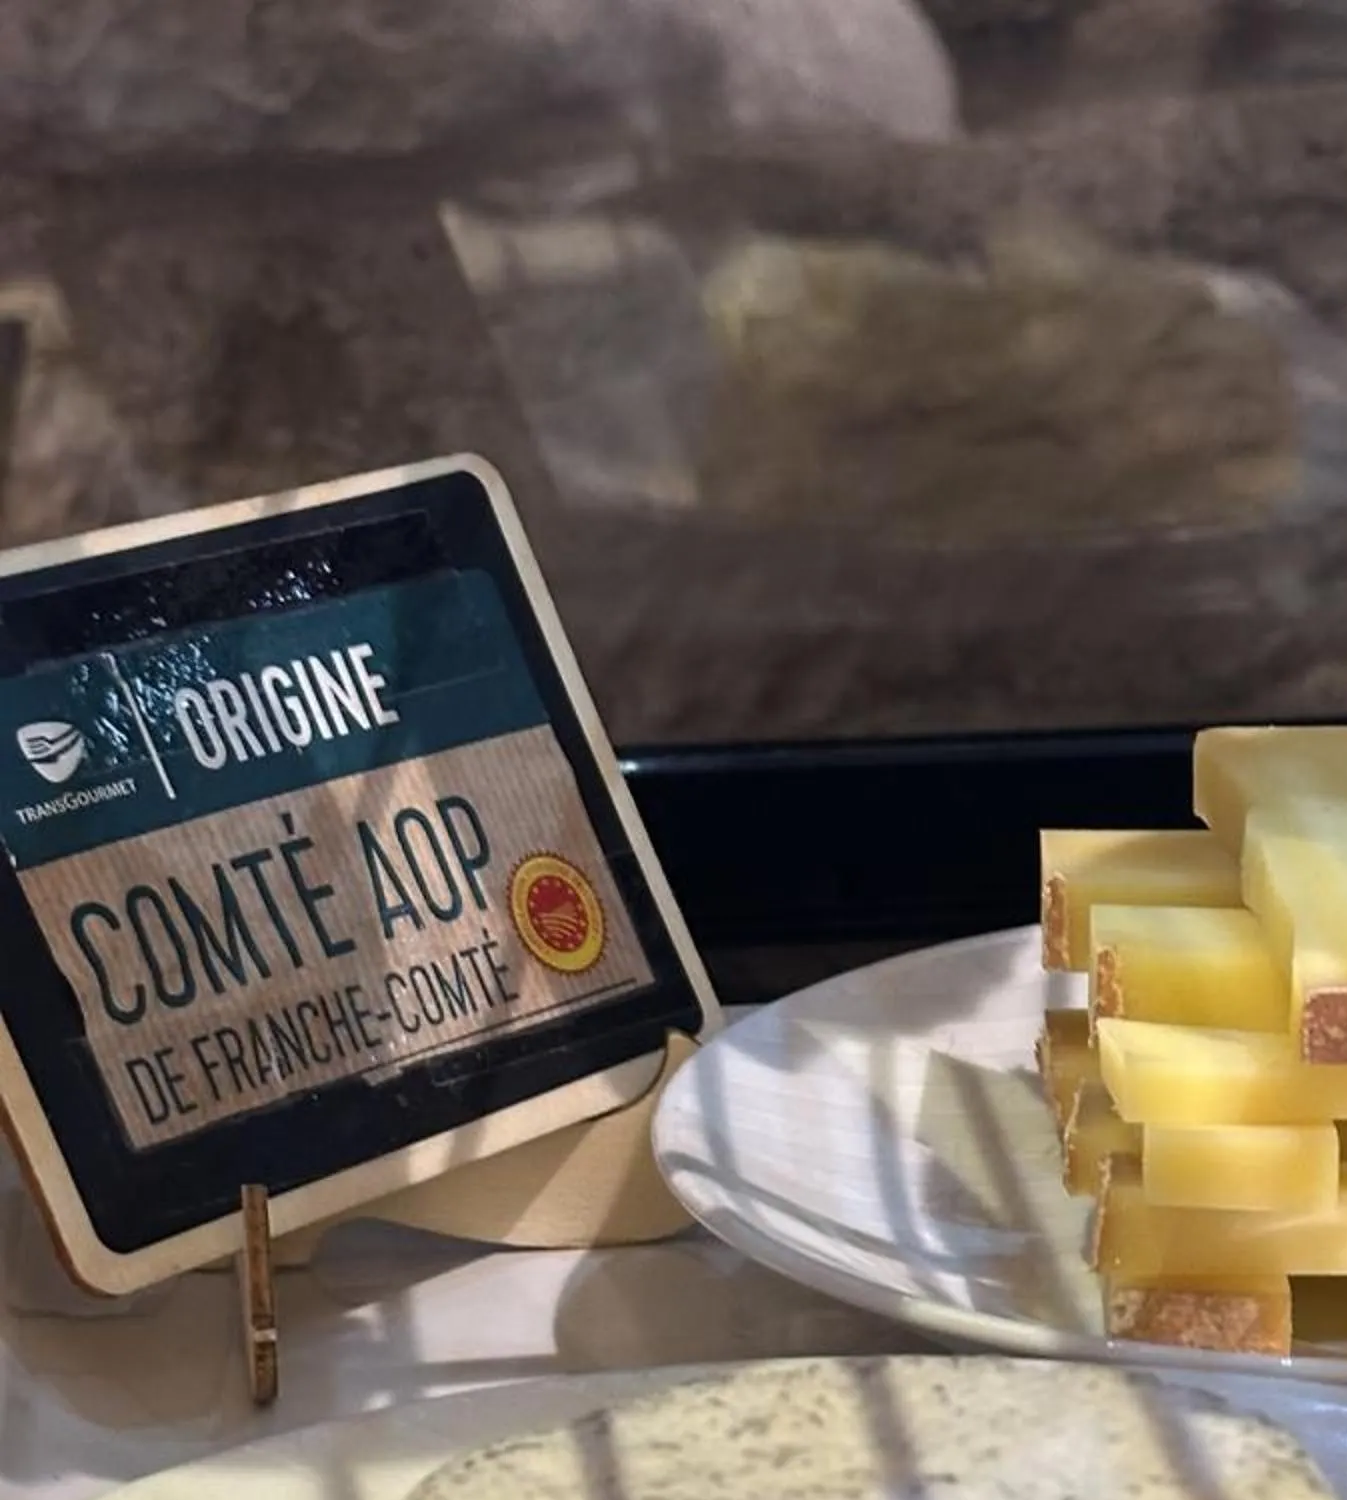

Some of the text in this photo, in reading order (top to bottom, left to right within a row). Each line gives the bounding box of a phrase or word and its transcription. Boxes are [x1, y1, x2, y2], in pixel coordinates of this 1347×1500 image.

[174, 643, 399, 770] ORIGINE
[69, 812, 356, 1025] COMTÉ
[356, 794, 491, 940] AOP
[125, 929, 519, 1125] DE FRANCHE-COMTÉ
